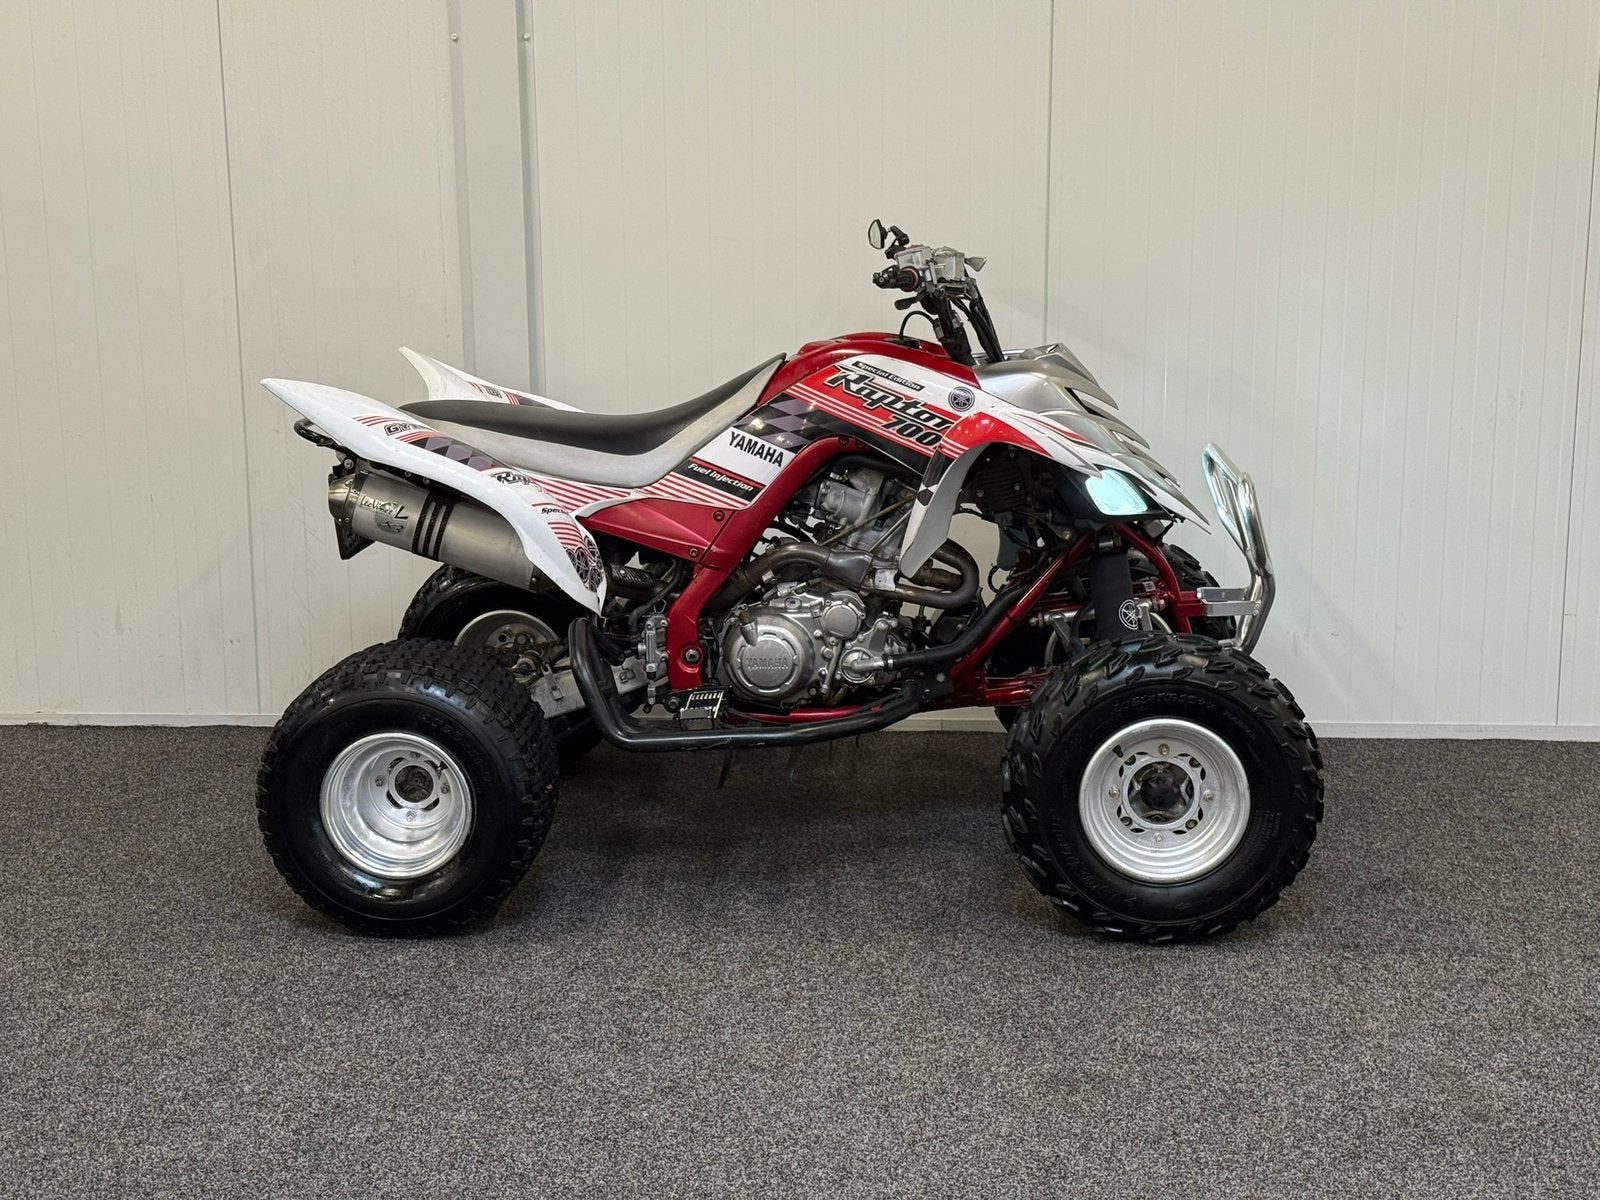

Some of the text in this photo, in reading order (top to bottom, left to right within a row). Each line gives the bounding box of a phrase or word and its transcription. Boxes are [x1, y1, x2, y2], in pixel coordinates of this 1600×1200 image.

[856, 362, 921, 390] Special Edition
[824, 365, 955, 431] Raptor
[384, 423, 428, 436] GY
[881, 415, 943, 446] 700
[728, 431, 784, 467] YAMAHA
[688, 463, 753, 492] Fuel Injection
[746, 657, 788, 670] YAMAHA
